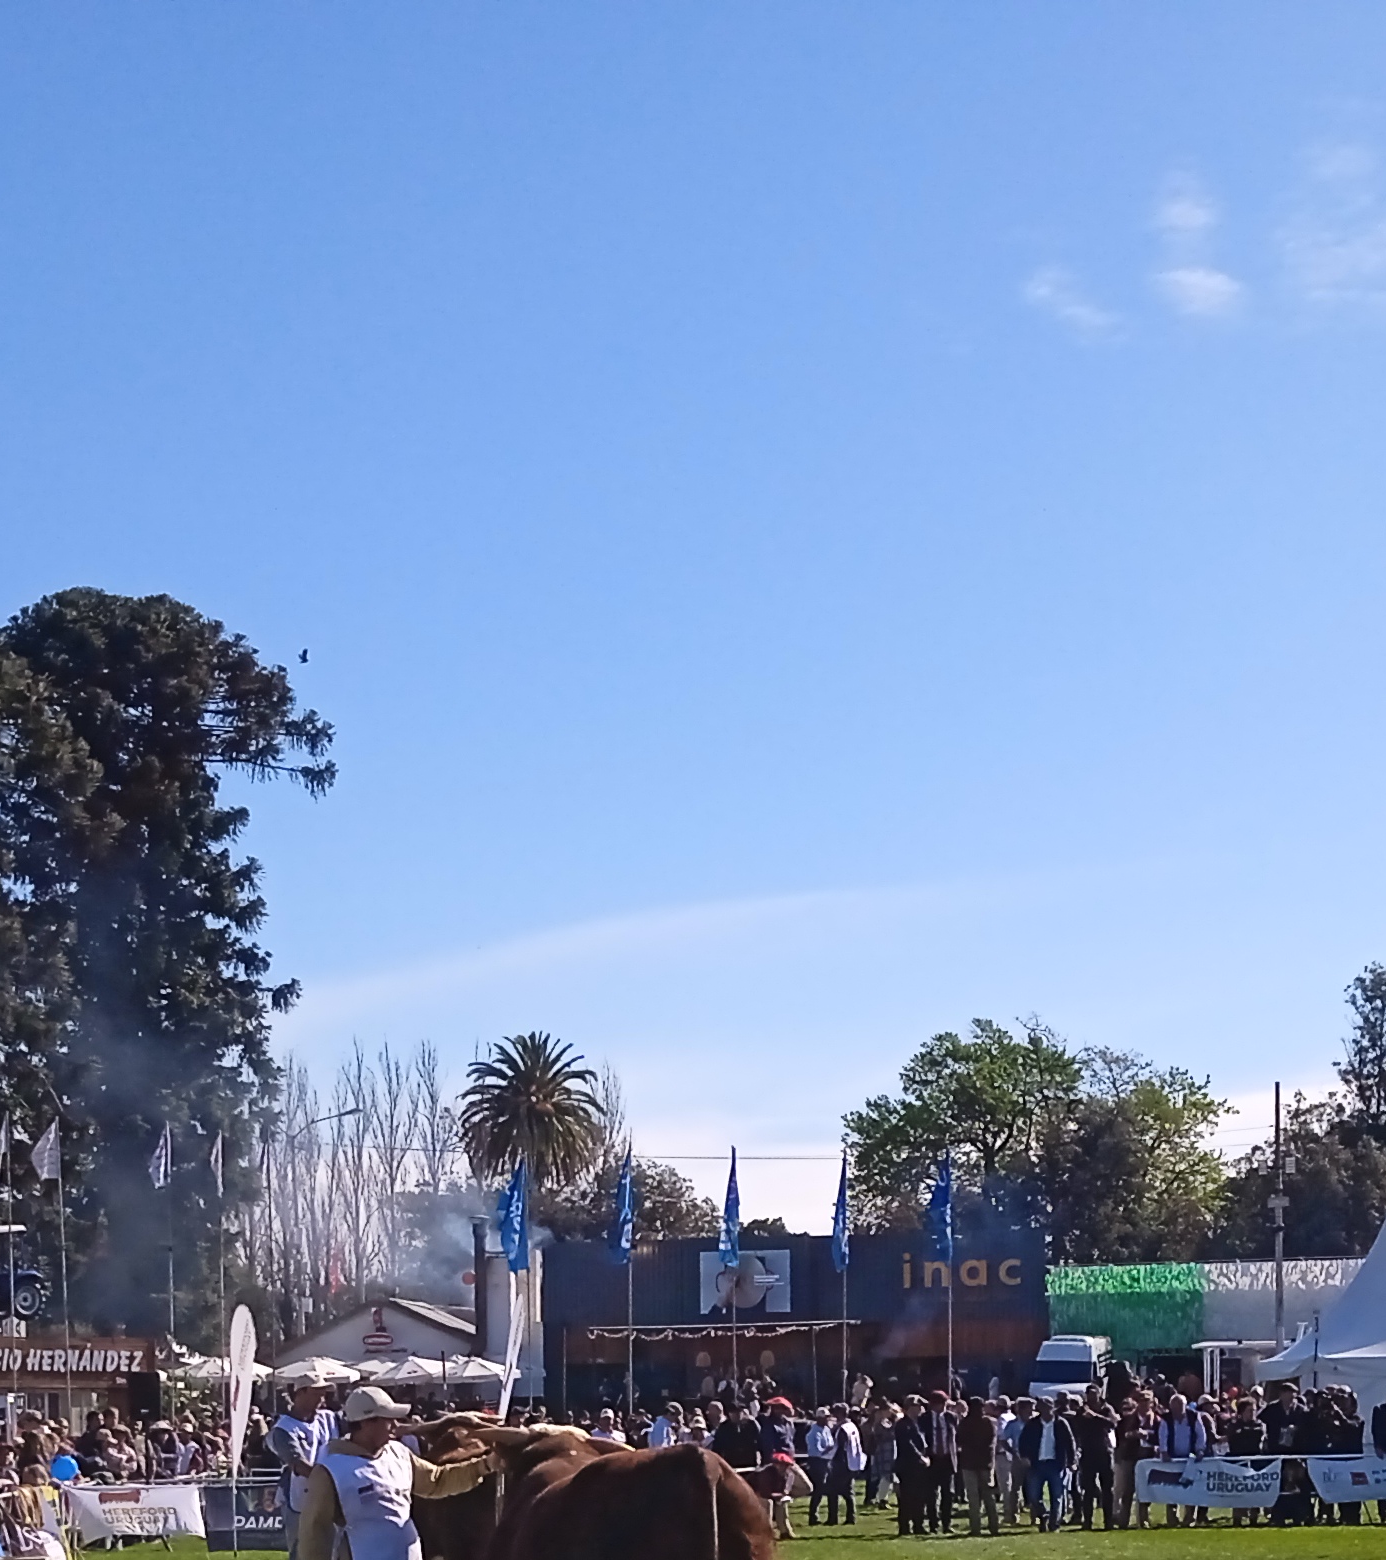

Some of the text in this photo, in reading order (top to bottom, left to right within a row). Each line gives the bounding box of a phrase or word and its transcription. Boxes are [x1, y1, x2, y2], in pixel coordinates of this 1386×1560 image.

[901, 1253, 1023, 1289] inac
[25, 1342, 144, 1373] HERNÁNDEZ
[1206, 1470, 1280, 1482] HEREFORD
[1206, 1481, 1273, 1493] URUGUAY
[102, 1506, 177, 1516] HEREFORD
